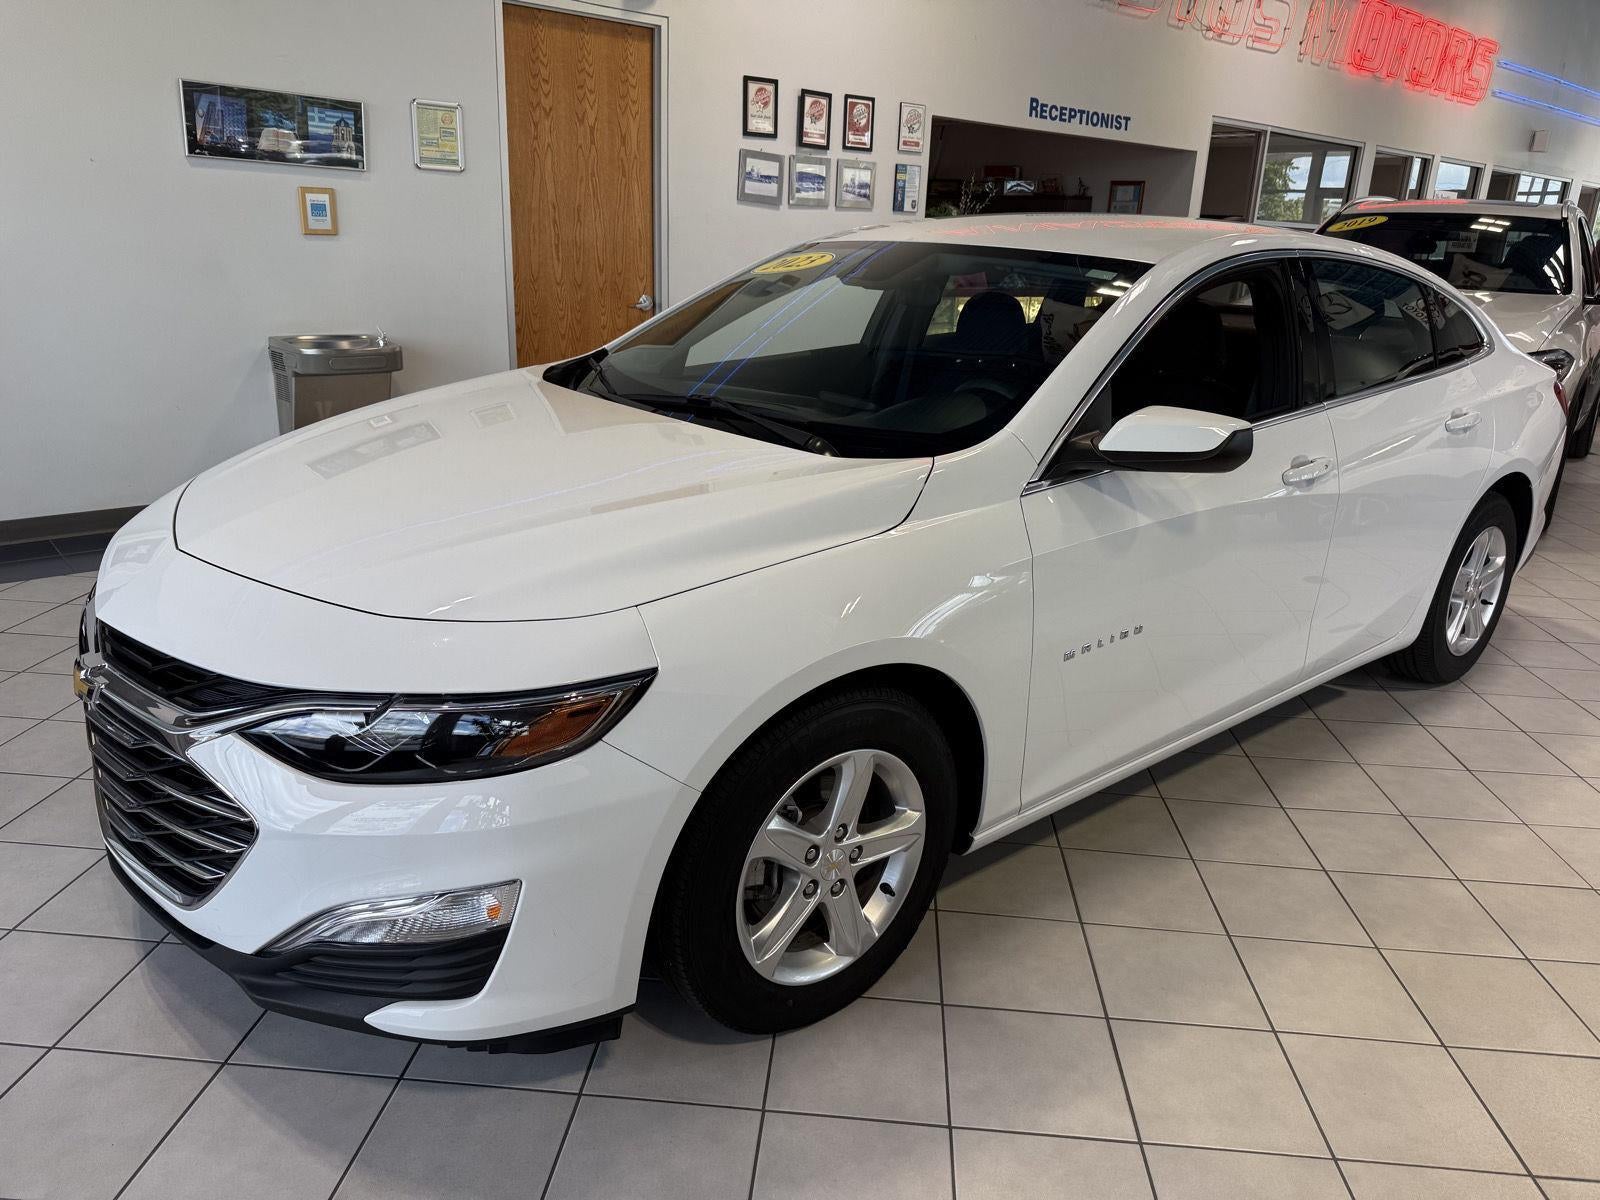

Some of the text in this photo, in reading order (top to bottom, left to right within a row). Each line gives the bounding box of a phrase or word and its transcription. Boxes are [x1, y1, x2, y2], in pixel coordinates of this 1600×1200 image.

[1297, 0, 1498, 103] MOTORS
[1336, 216, 1378, 230] 2019
[1063, 623, 1144, 662] MALIBU
